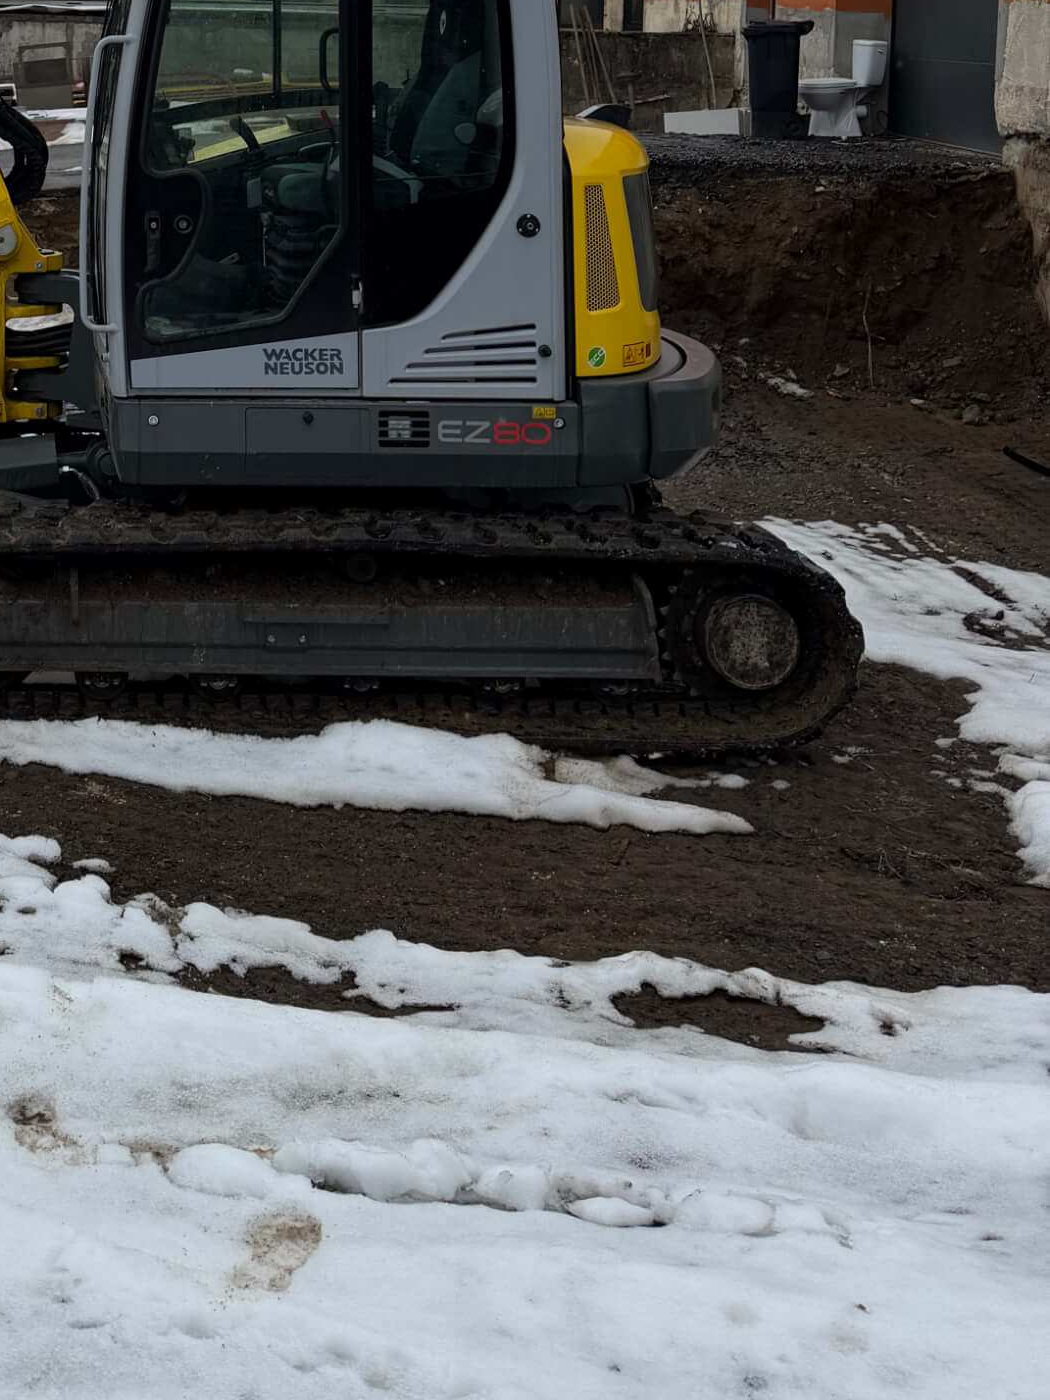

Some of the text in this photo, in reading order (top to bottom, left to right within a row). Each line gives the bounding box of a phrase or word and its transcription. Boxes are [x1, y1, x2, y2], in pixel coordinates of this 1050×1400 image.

[262, 348, 343, 361] WACKER
[264, 362, 344, 375] NEUSON
[438, 420, 551, 445] EZ80
